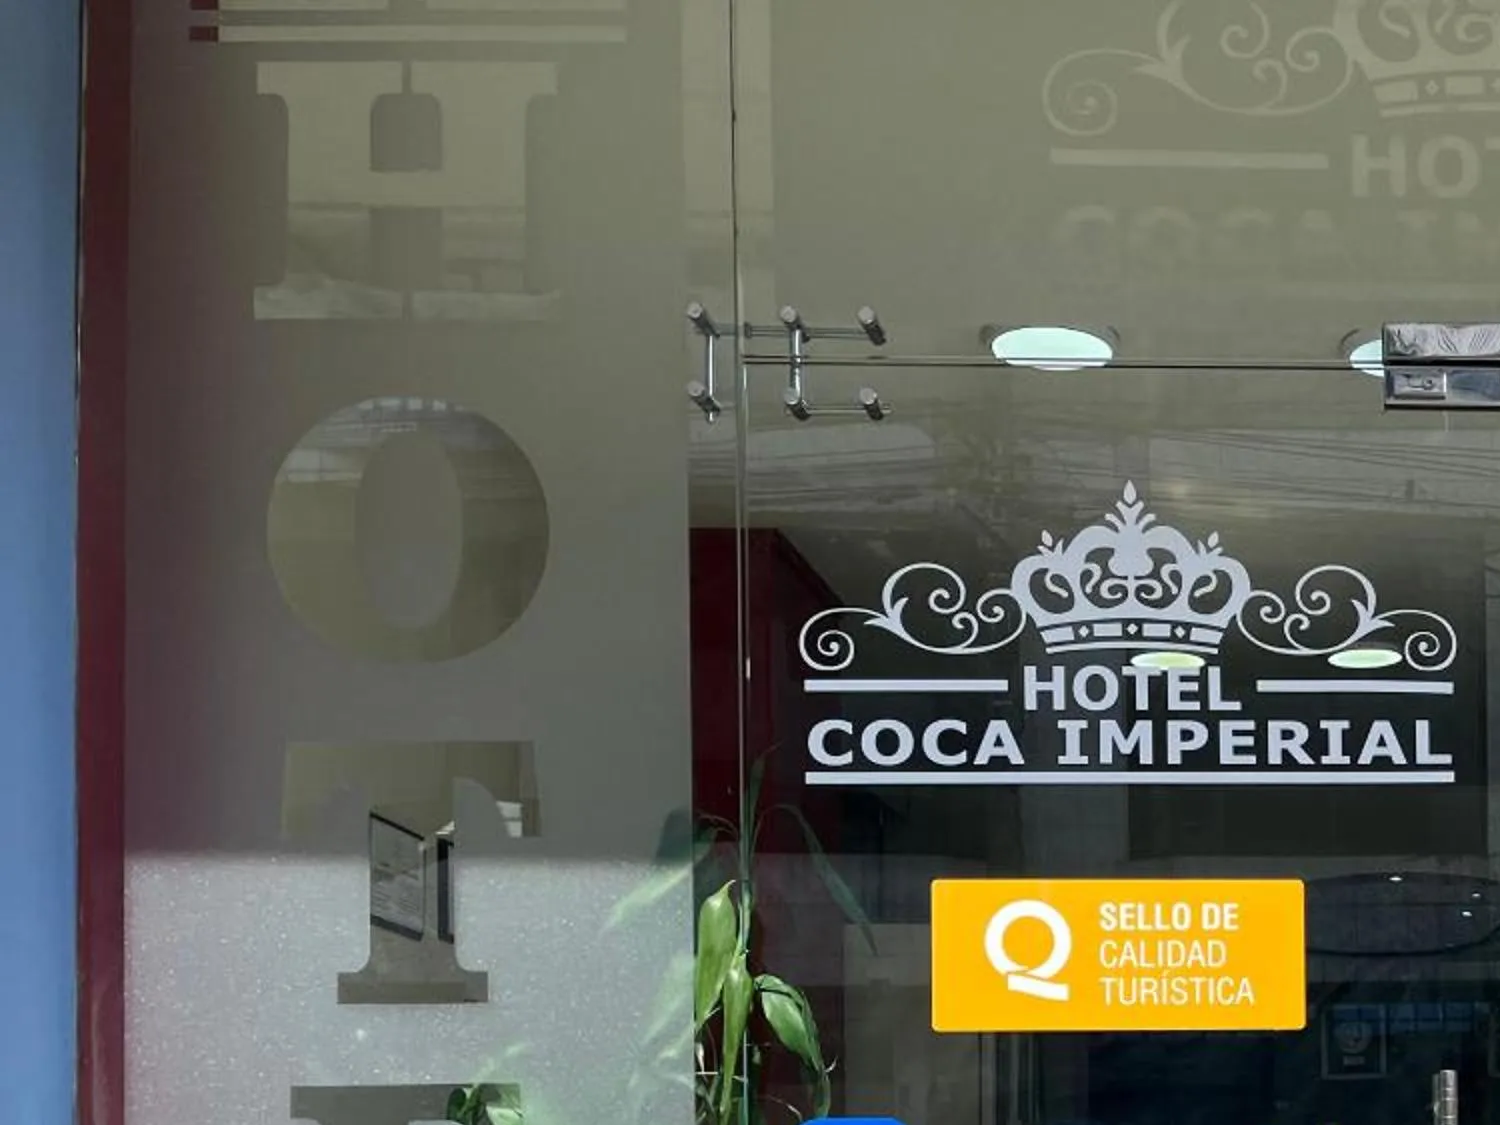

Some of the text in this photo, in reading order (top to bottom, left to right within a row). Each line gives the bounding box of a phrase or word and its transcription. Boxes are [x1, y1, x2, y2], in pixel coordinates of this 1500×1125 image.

[1024, 665, 1241, 711] HOTEL
[807, 719, 1452, 766] COCA IMPERIAL
[1099, 902, 1239, 931] SELLO DE
[1099, 939, 1227, 968] CALIDAD
[1101, 970, 1254, 1005] TURÍSTICA
